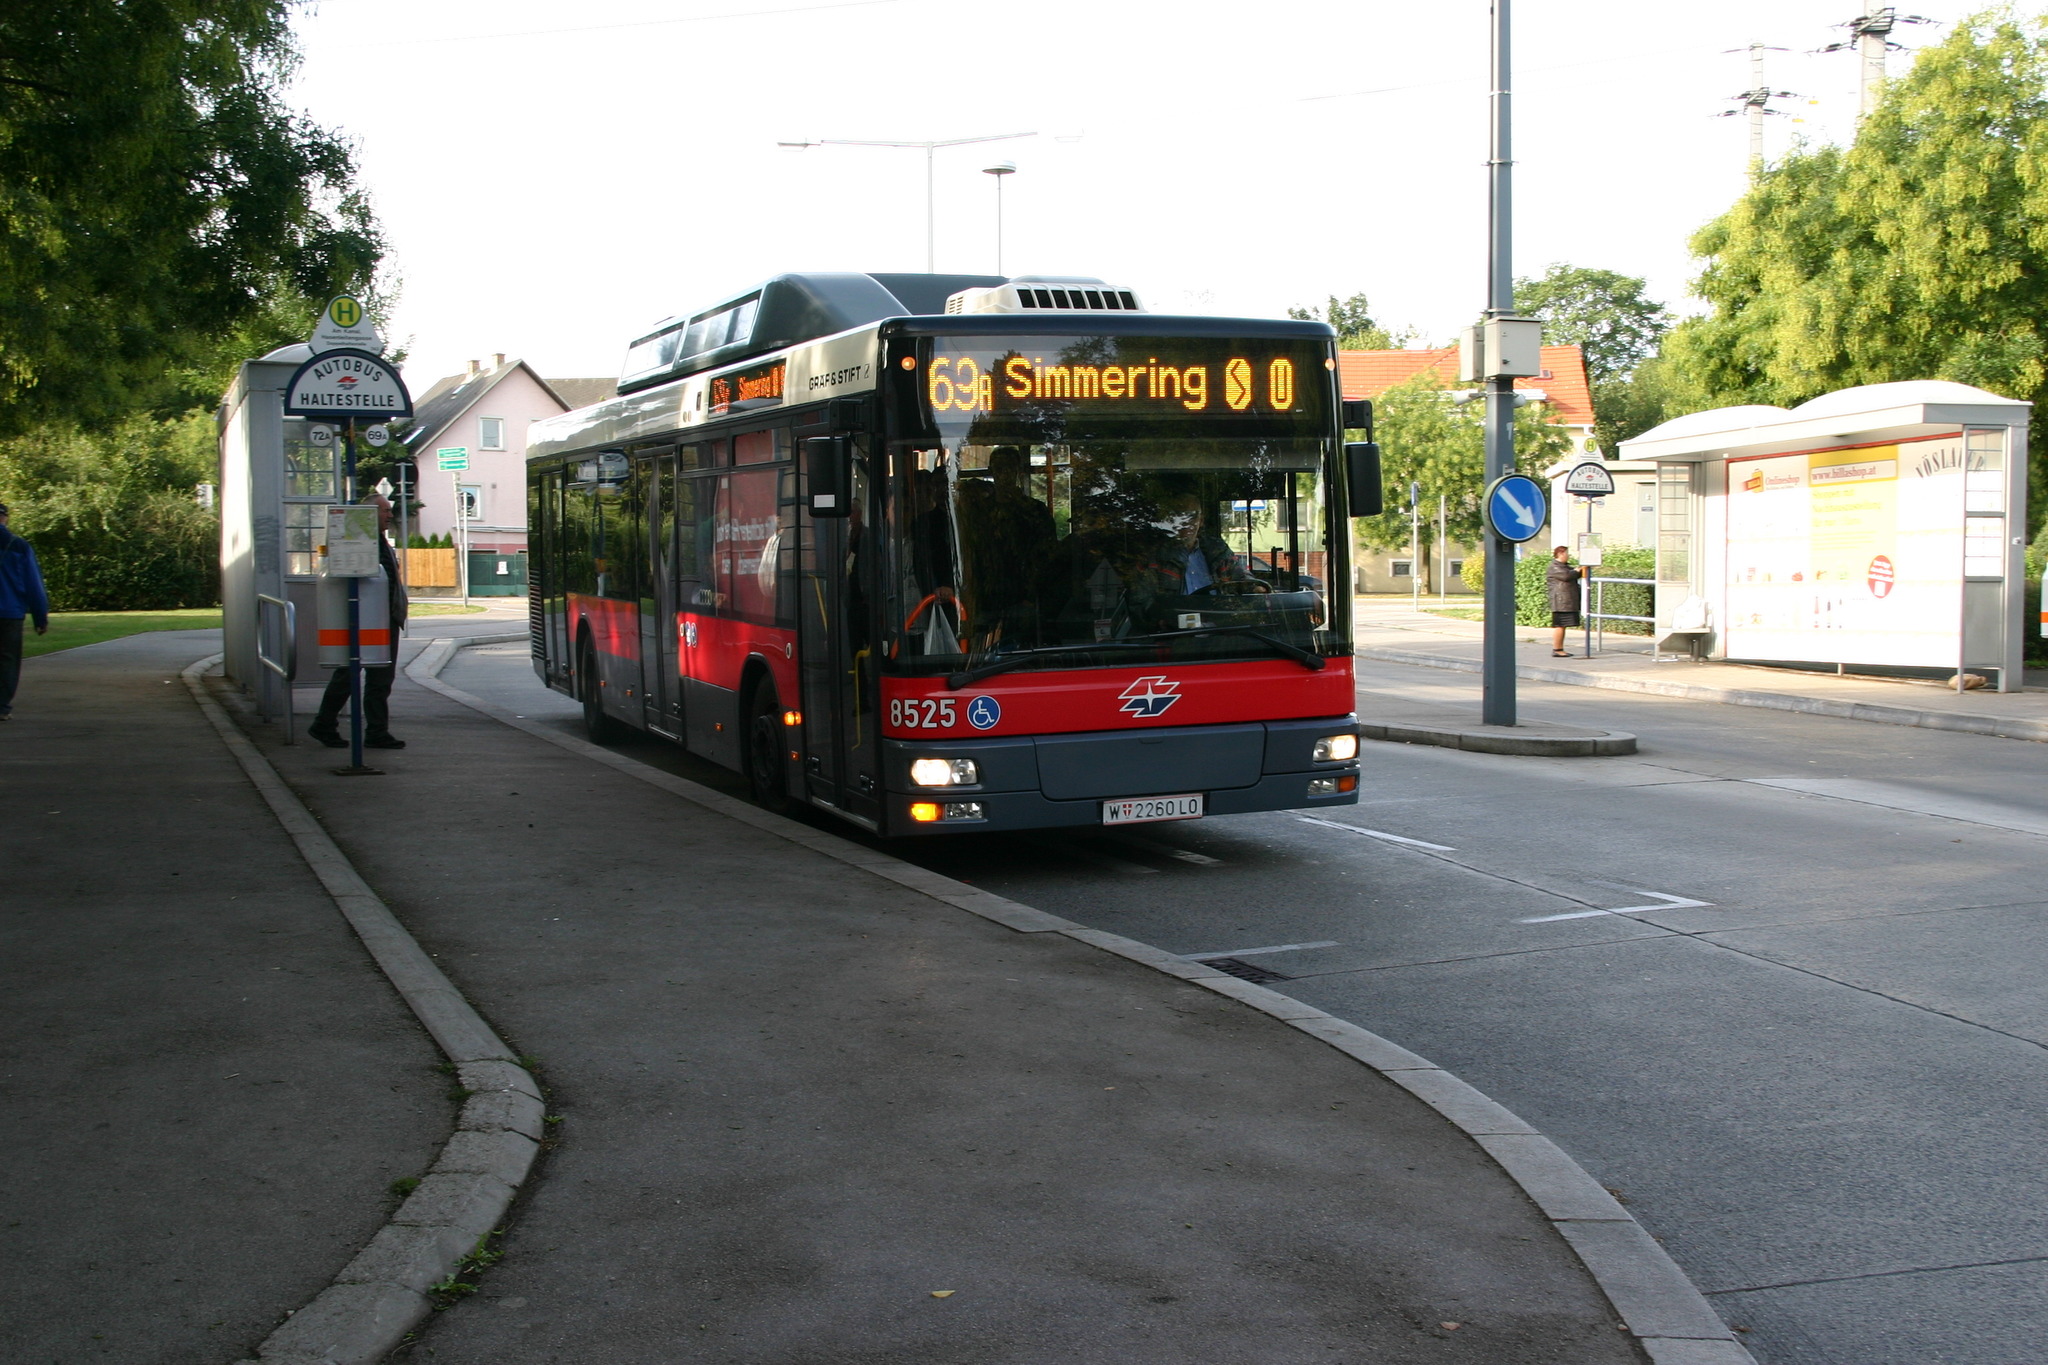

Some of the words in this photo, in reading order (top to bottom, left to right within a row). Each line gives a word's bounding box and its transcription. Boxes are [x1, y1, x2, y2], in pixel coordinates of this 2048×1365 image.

[337, 302, 354, 322] H
[313, 359, 383, 382] AUTOBUS
[929, 357, 992, 411] 69A
[1005, 357, 1207, 410] Simmering
[301, 393, 394, 407] HALTESTELLE
[312, 431, 331, 441] 72A
[367, 430, 387, 440] 69A
[1586, 440, 1594, 450] H
[1577, 466, 1604, 478] AUTOBUS
[890, 698, 956, 728] 8525
[1109, 805, 1120, 820] W
[1135, 800, 1174, 818] 2260
[1180, 798, 1198, 814] LO
